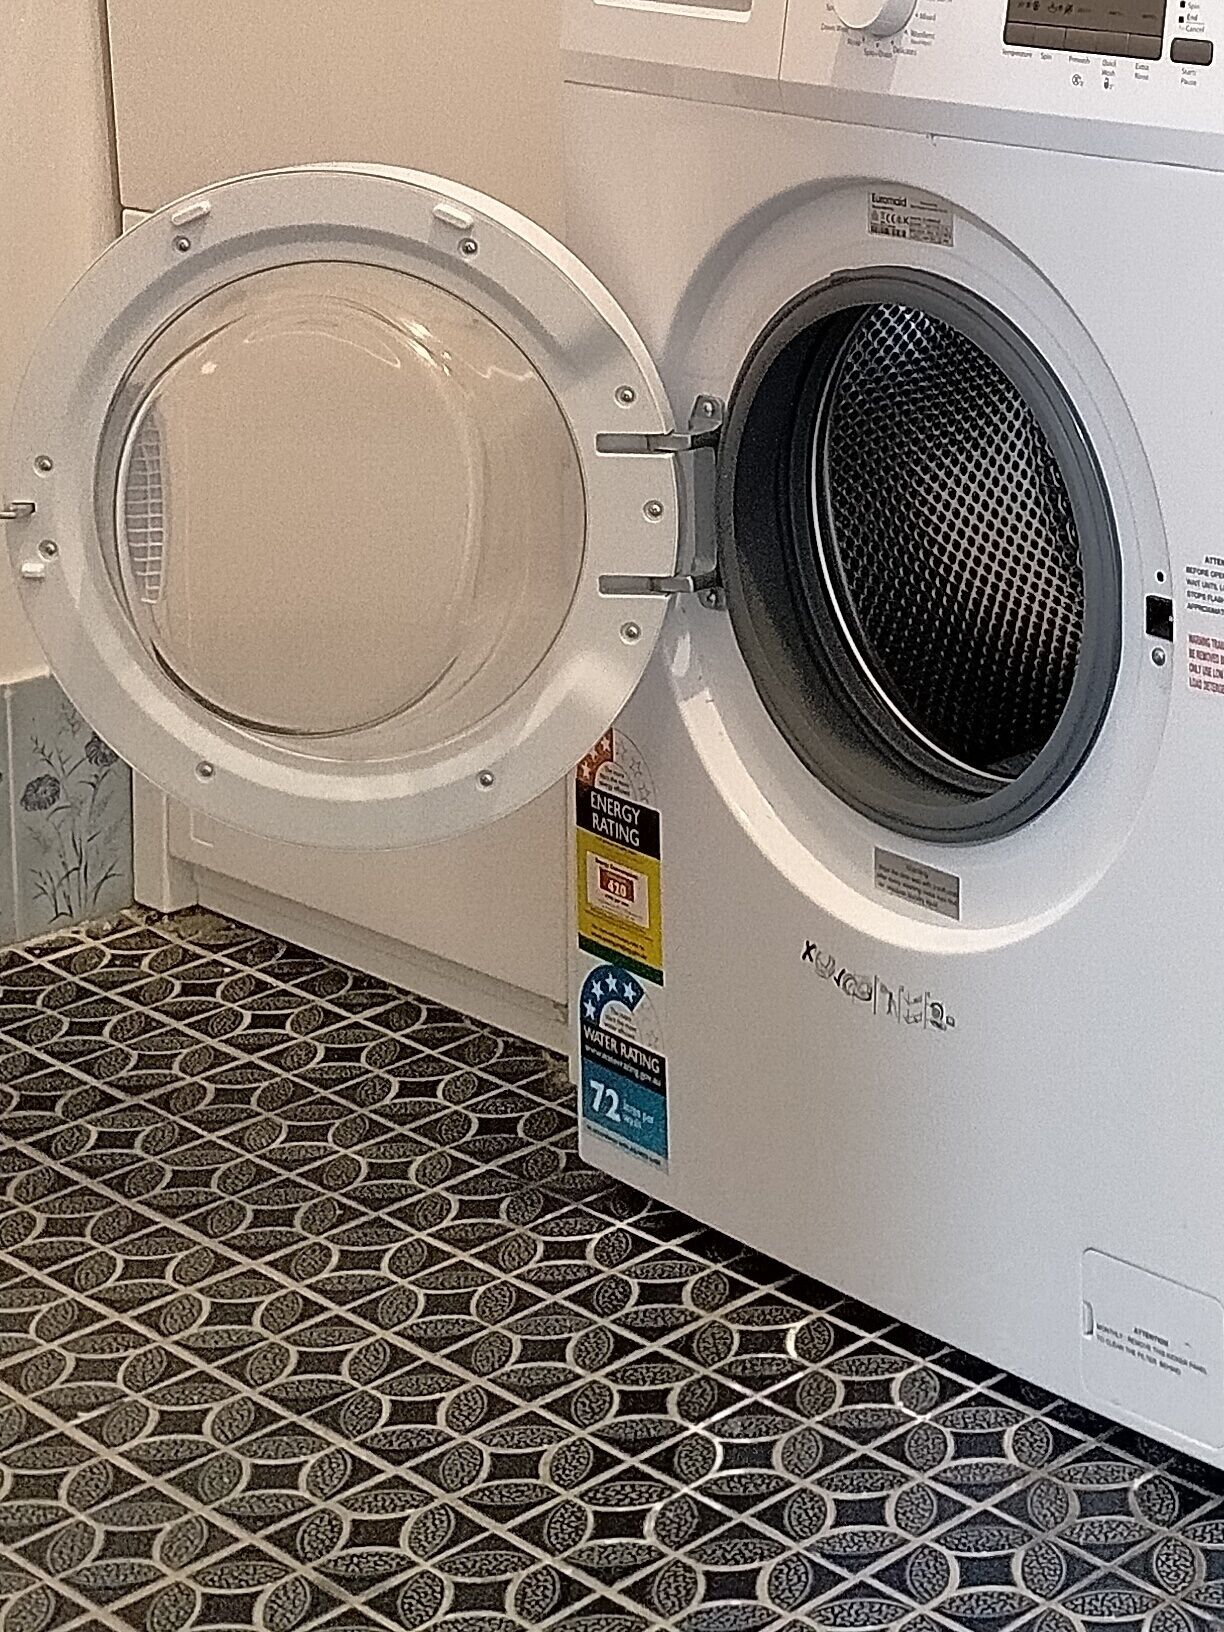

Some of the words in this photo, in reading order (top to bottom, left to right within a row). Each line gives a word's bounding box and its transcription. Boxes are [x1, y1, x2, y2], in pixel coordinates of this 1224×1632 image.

[590, 790, 640, 826] ENERGY
[592, 812, 640, 847] RATING
[583, 1024, 619, 1055] WATER
[620, 1041, 660, 1075] RATING
[589, 1079, 621, 1123] 72
